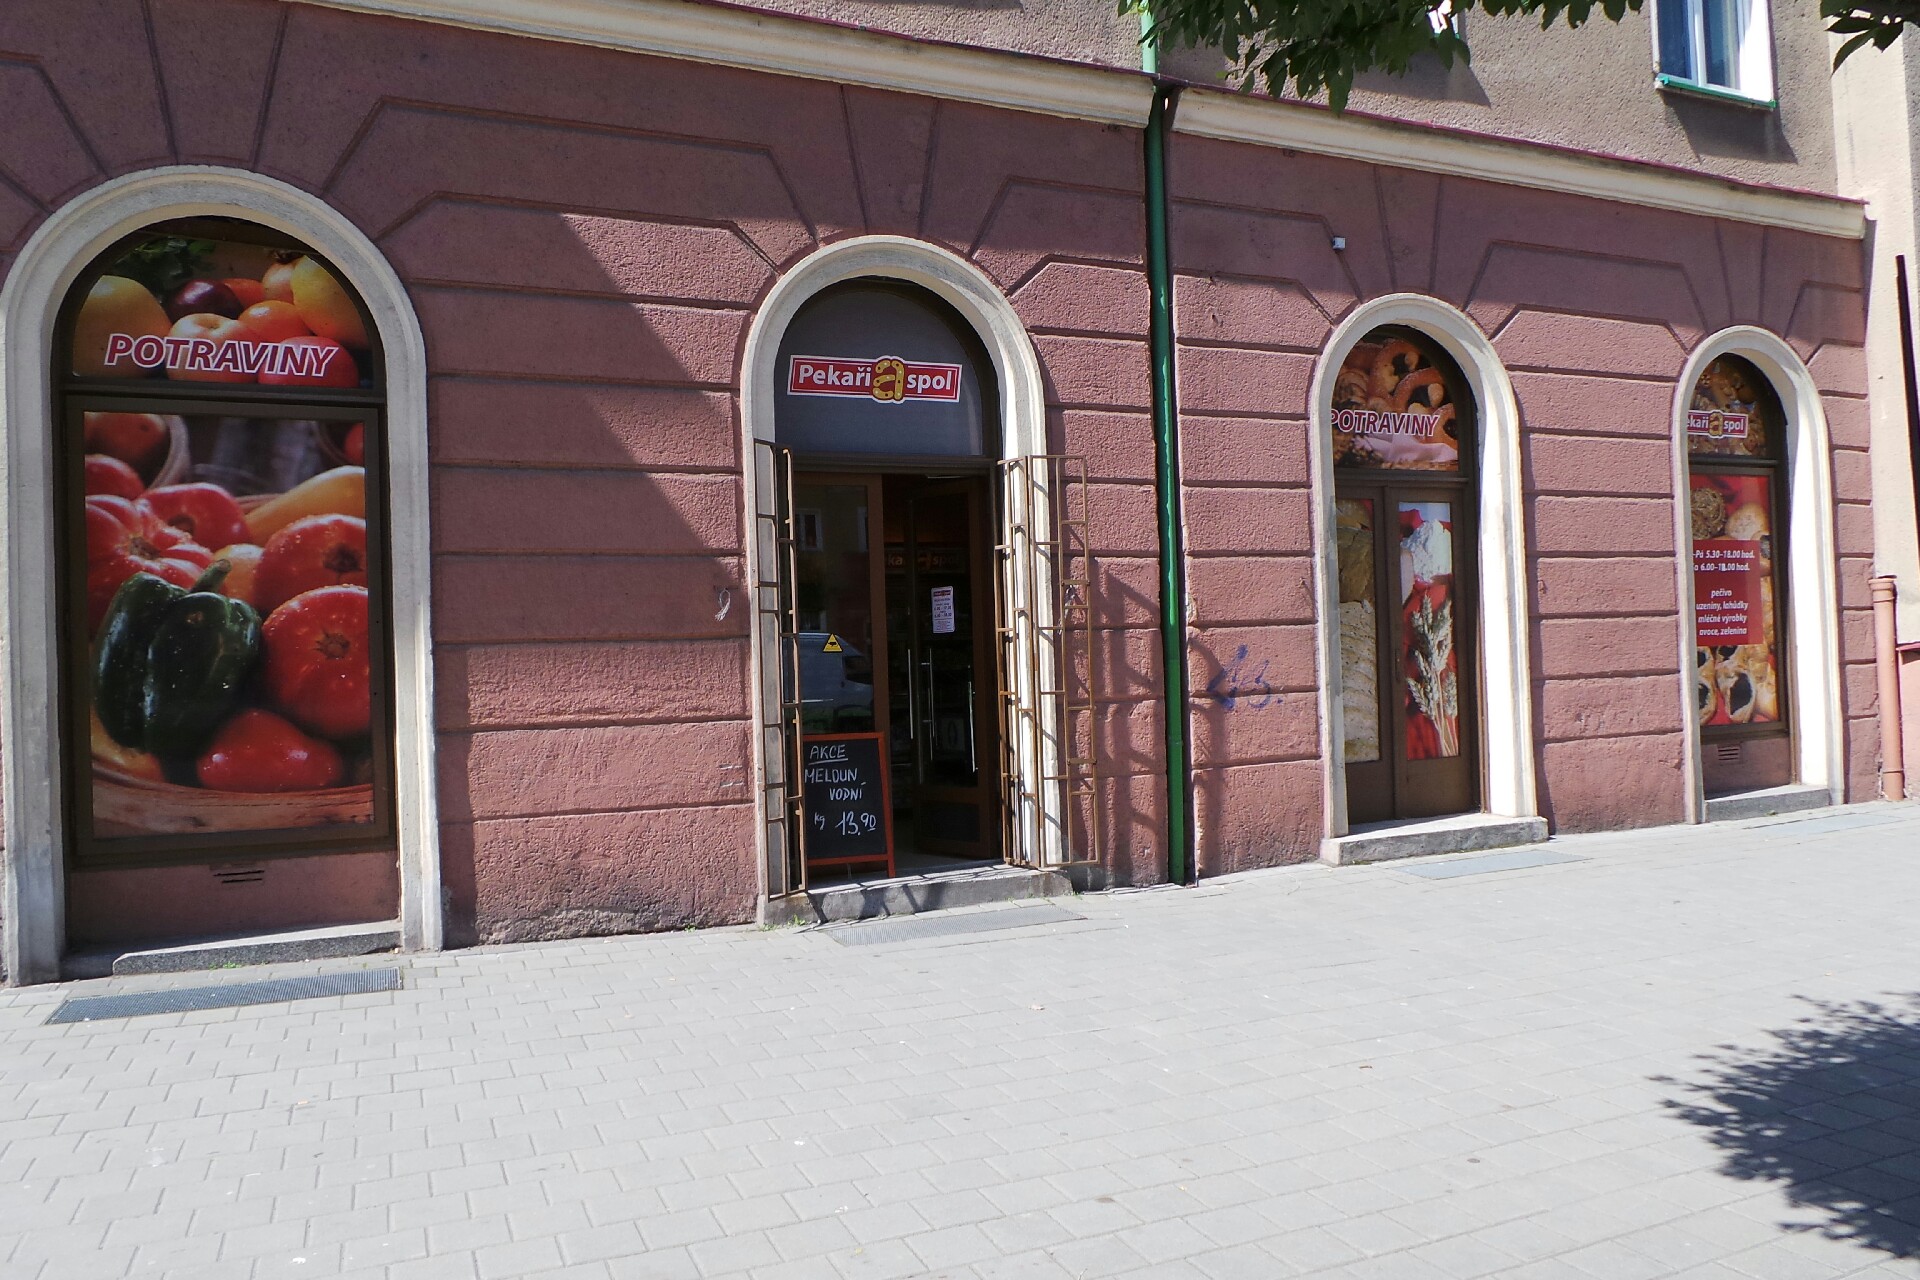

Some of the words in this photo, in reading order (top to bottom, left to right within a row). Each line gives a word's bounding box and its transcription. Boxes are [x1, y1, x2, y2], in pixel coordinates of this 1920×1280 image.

[105, 333, 339, 377] POTRAVINY
[799, 364, 871, 387] Pekaři
[872, 358, 904, 401] a
[906, 370, 952, 394] spol
[1687, 414, 1709, 428] kaři
[1723, 418, 1744, 433] spol
[1741, 549, 1755, 559] hod.
[1736, 562, 1751, 571] hod.
[1711, 587, 1733, 599] pečivo
[1696, 600, 1722, 612] uzeniny,
[1723, 600, 1749, 611] lahůdky
[1698, 613, 1721, 623] mléčné
[1722, 613, 1748, 624] výrobky
[1699, 628, 1719, 637] ovoce,
[1720, 626, 1748, 636] zelenina
[809, 744, 847, 760] AKCE
[804, 767, 858, 784] MELOUN
[829, 781, 867, 801] VODNÍ
